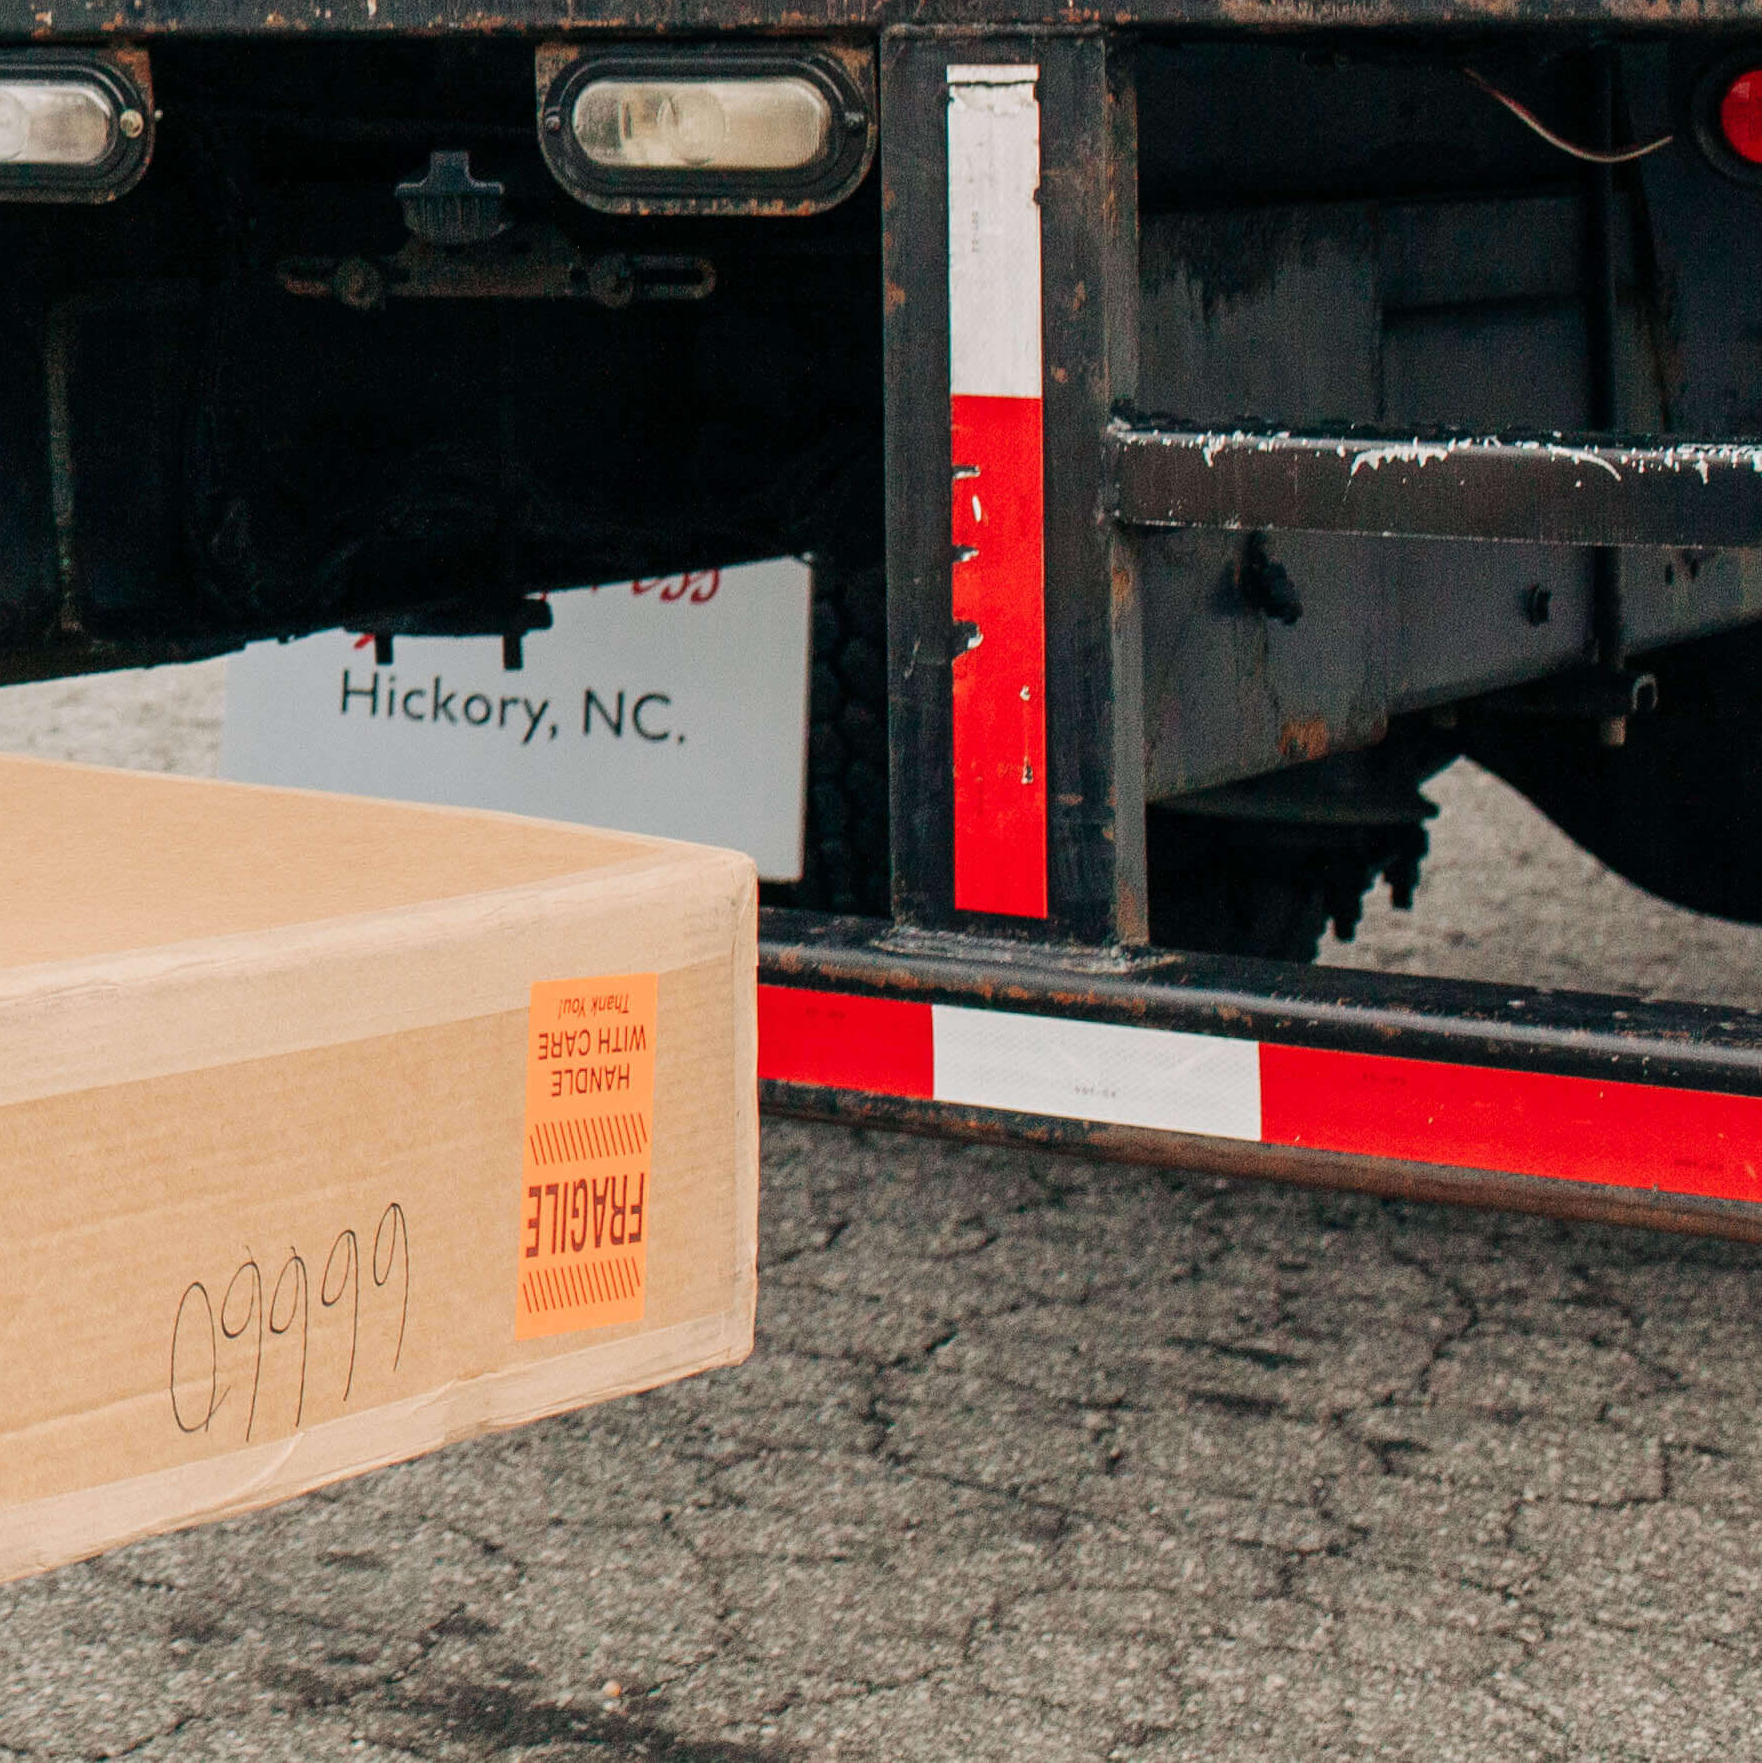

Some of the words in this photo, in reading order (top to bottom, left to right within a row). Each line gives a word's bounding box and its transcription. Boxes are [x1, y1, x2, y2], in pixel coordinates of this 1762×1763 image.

[340, 668, 558, 746] Hickory,
[582, 686, 686, 744] NC.
[557, 996, 587, 1021] You!
[592, 992, 631, 1015] Thank
[537, 1028, 592, 1061] CARE
[597, 1024, 647, 1055] WITH
[550, 1062, 631, 1098] HANDLE
[525, 1172, 645, 1259] FRAGILE
